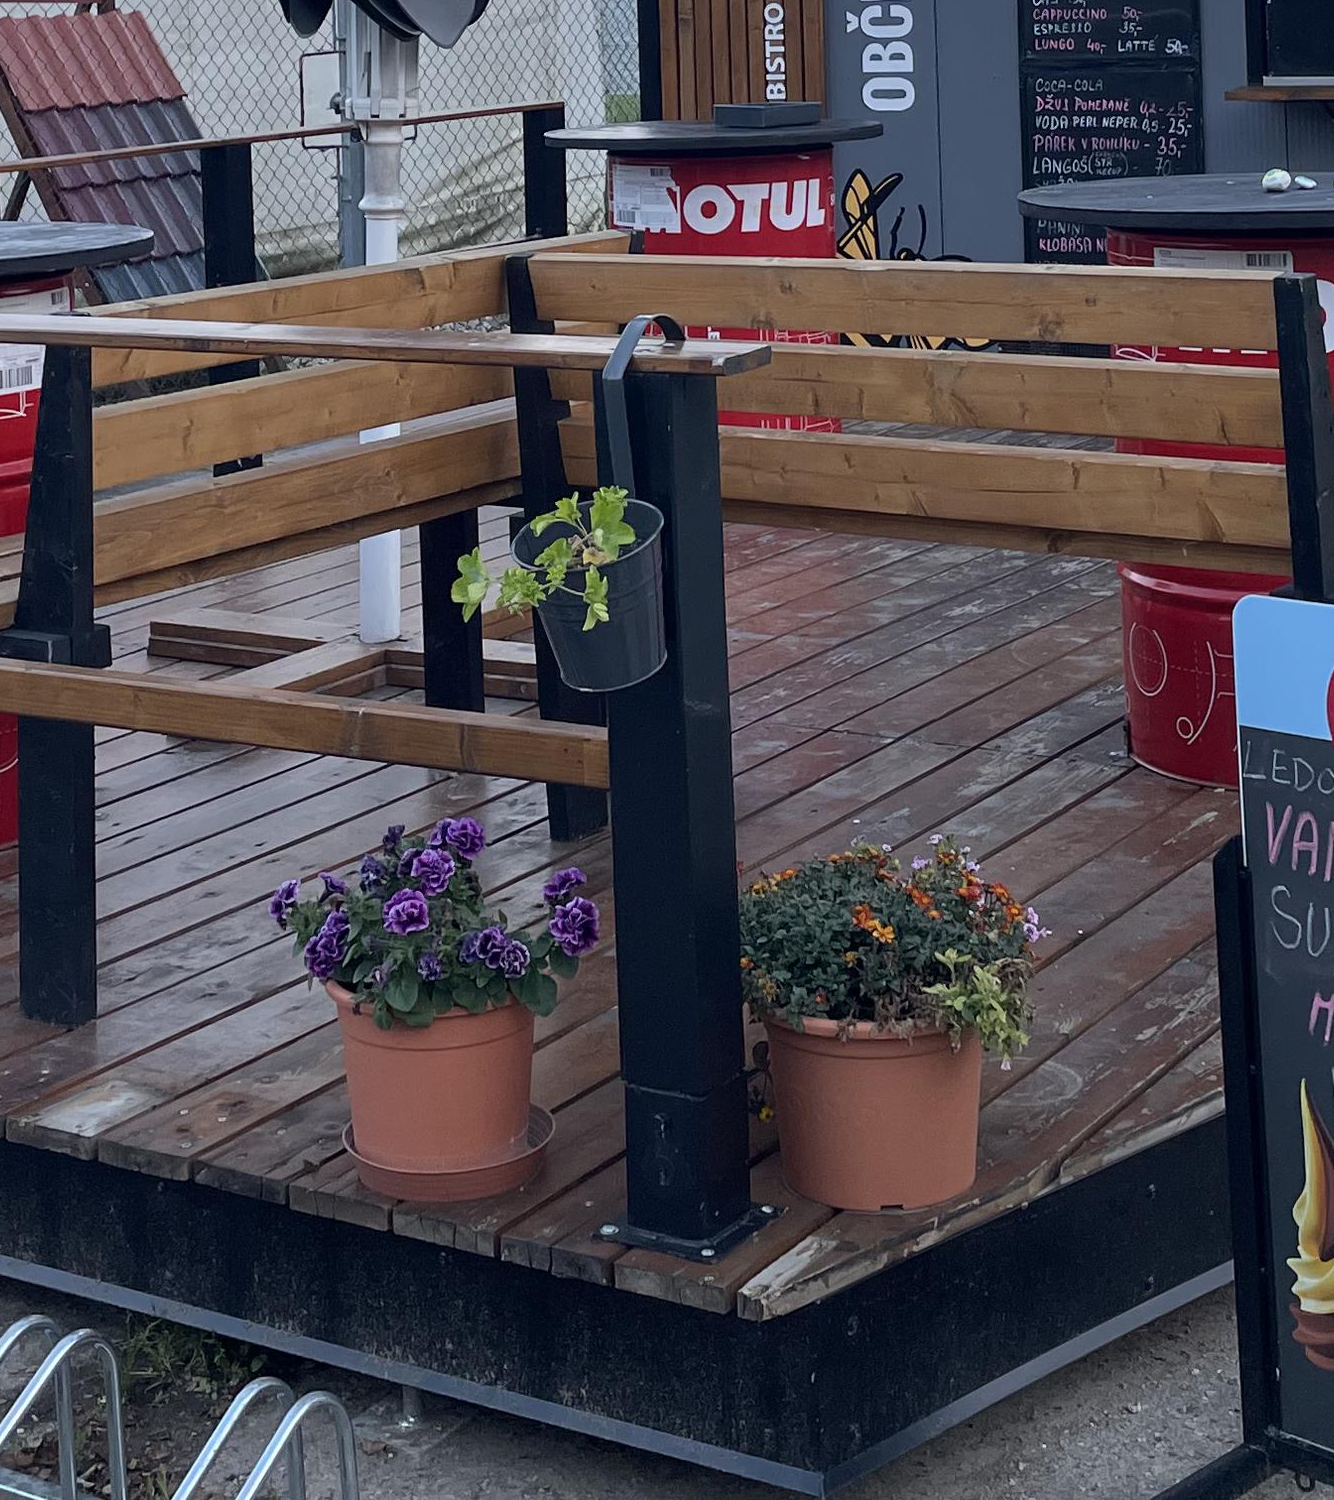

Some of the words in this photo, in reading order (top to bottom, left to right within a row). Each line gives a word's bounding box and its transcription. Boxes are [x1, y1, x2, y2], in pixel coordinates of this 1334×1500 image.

[1033, 8, 1107, 20] CAPPUCCINO
[1034, 22, 1092, 35] ESPRESSO
[1035, 38, 1075, 51] LUNGO
[764, 2, 786, 103] BISTRO
[1036, 78, 1103, 92] COCA-COLA
[1035, 115, 1067, 130] VODA
[1033, 131, 1075, 152] PÁREK
[1082, 138, 1088, 150] V
